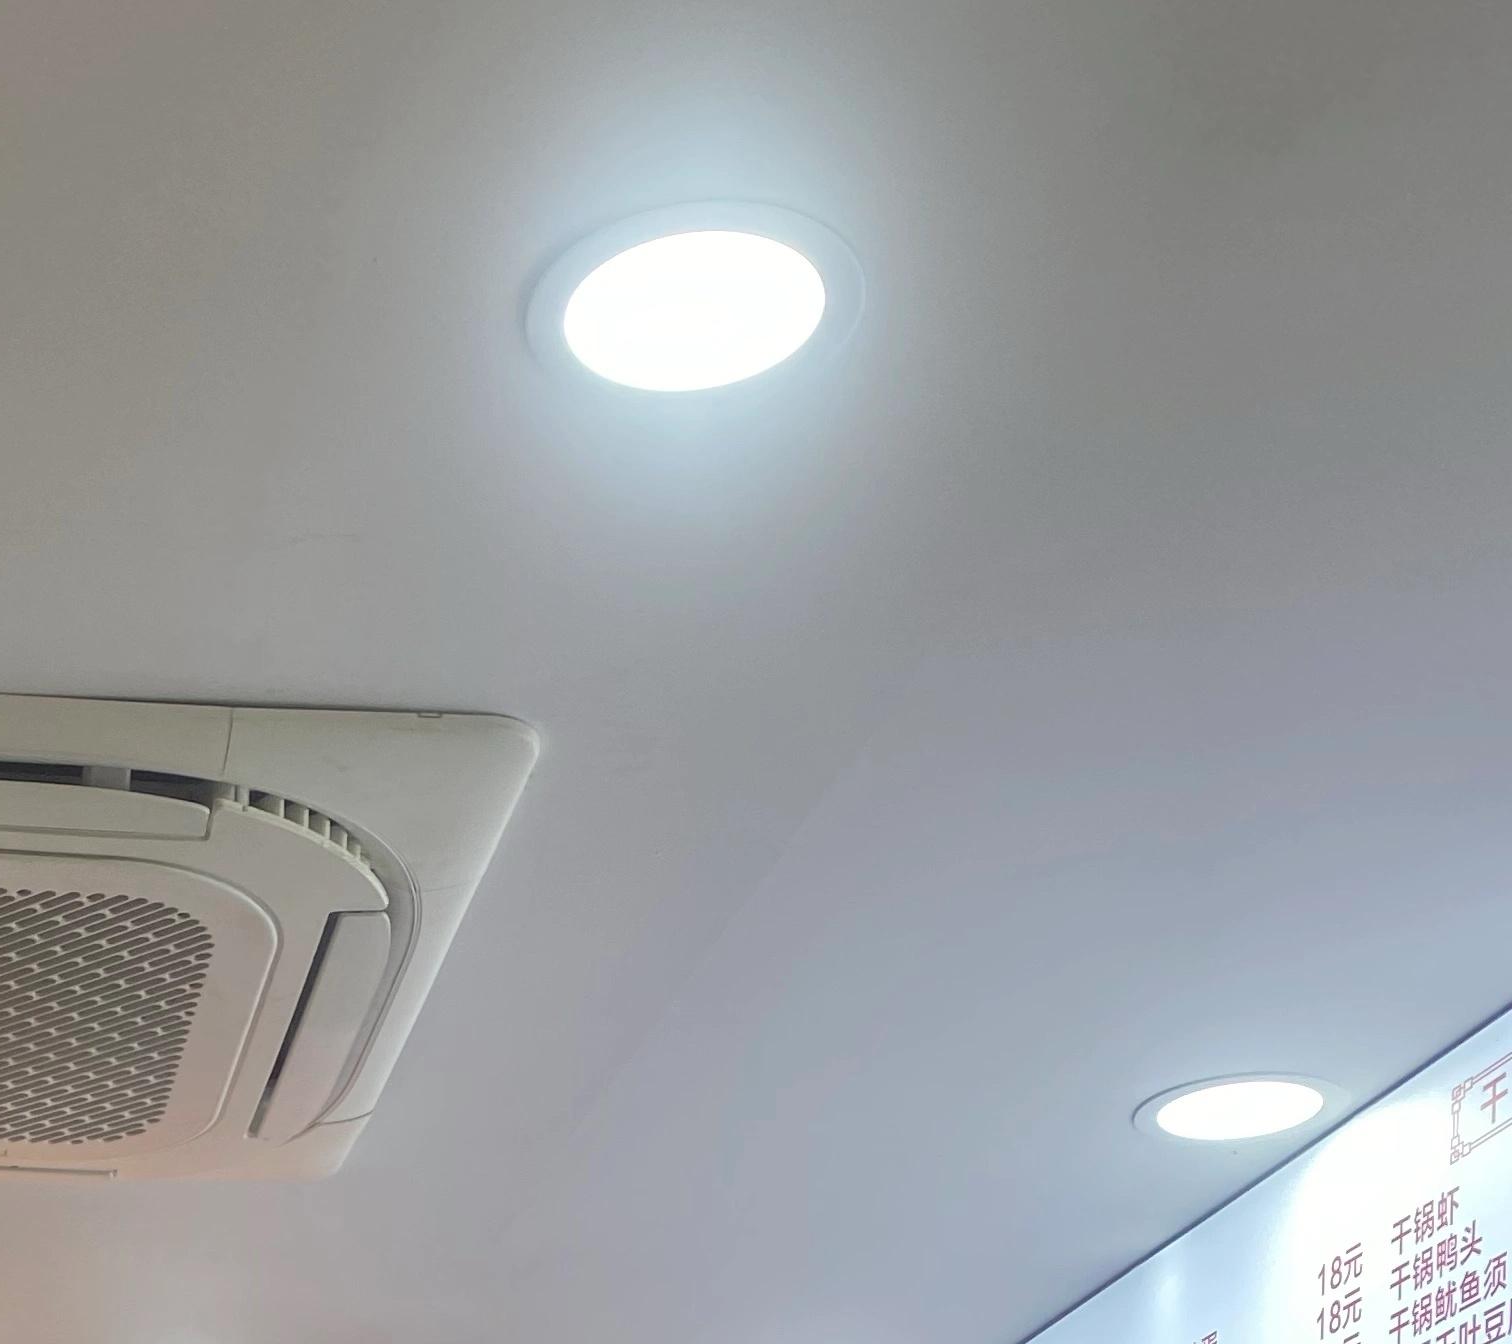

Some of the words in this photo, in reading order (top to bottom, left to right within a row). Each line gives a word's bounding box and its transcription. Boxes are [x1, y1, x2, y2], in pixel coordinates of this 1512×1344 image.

[1391, 1187, 1459, 1251] 干锅虾
[1318, 1242, 1363, 1295] 18元
[1389, 1225, 1483, 1296] 干锅鸭头
[1389, 1251, 1507, 1341] 干锅鱿鱼须
